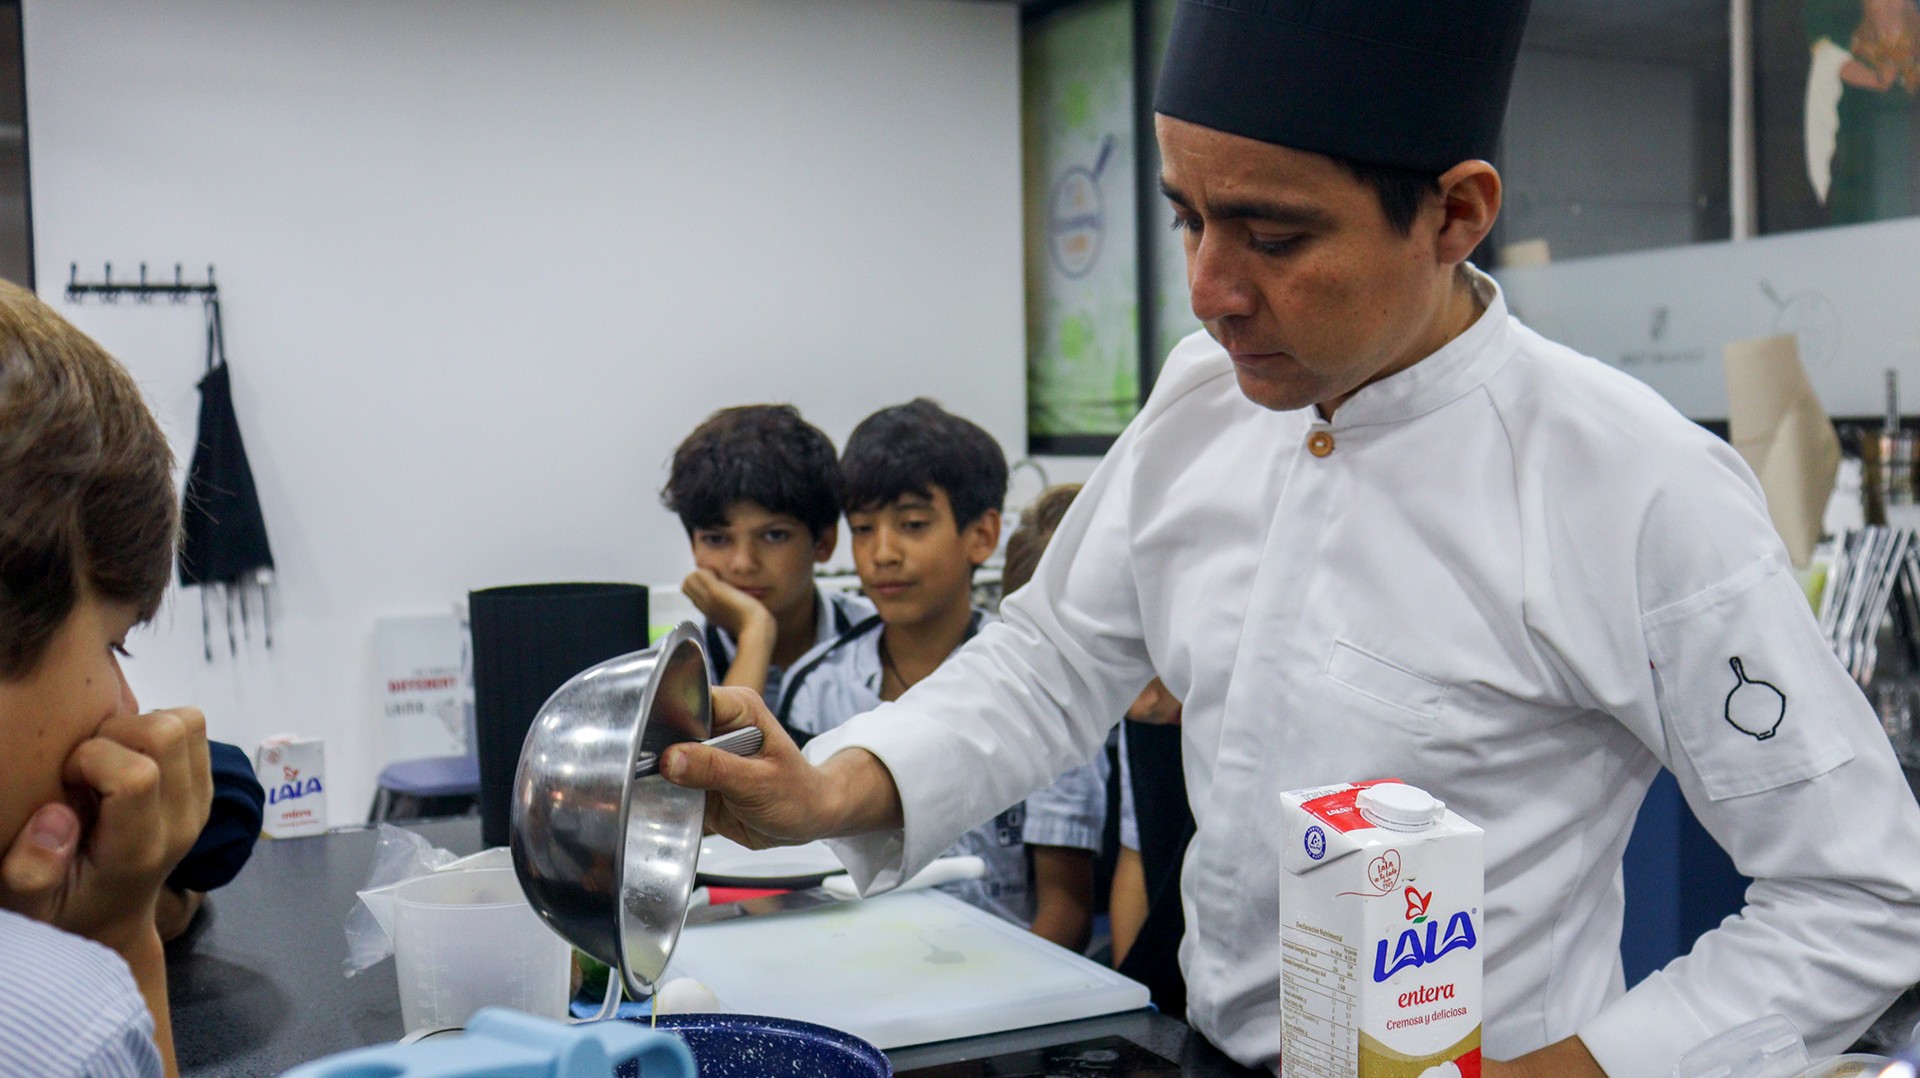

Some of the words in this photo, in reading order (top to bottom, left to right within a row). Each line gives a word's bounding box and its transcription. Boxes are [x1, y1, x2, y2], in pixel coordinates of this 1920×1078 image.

[269, 777, 322, 804] LALA
[281, 809, 312, 819] entera
[1373, 911, 1477, 983] LALA
[1398, 983, 1455, 1008] entera
[1386, 1015, 1424, 1031] Cremosa
[1425, 1014, 1431, 1025] y
[1432, 1006, 1468, 1021] deliciosa
